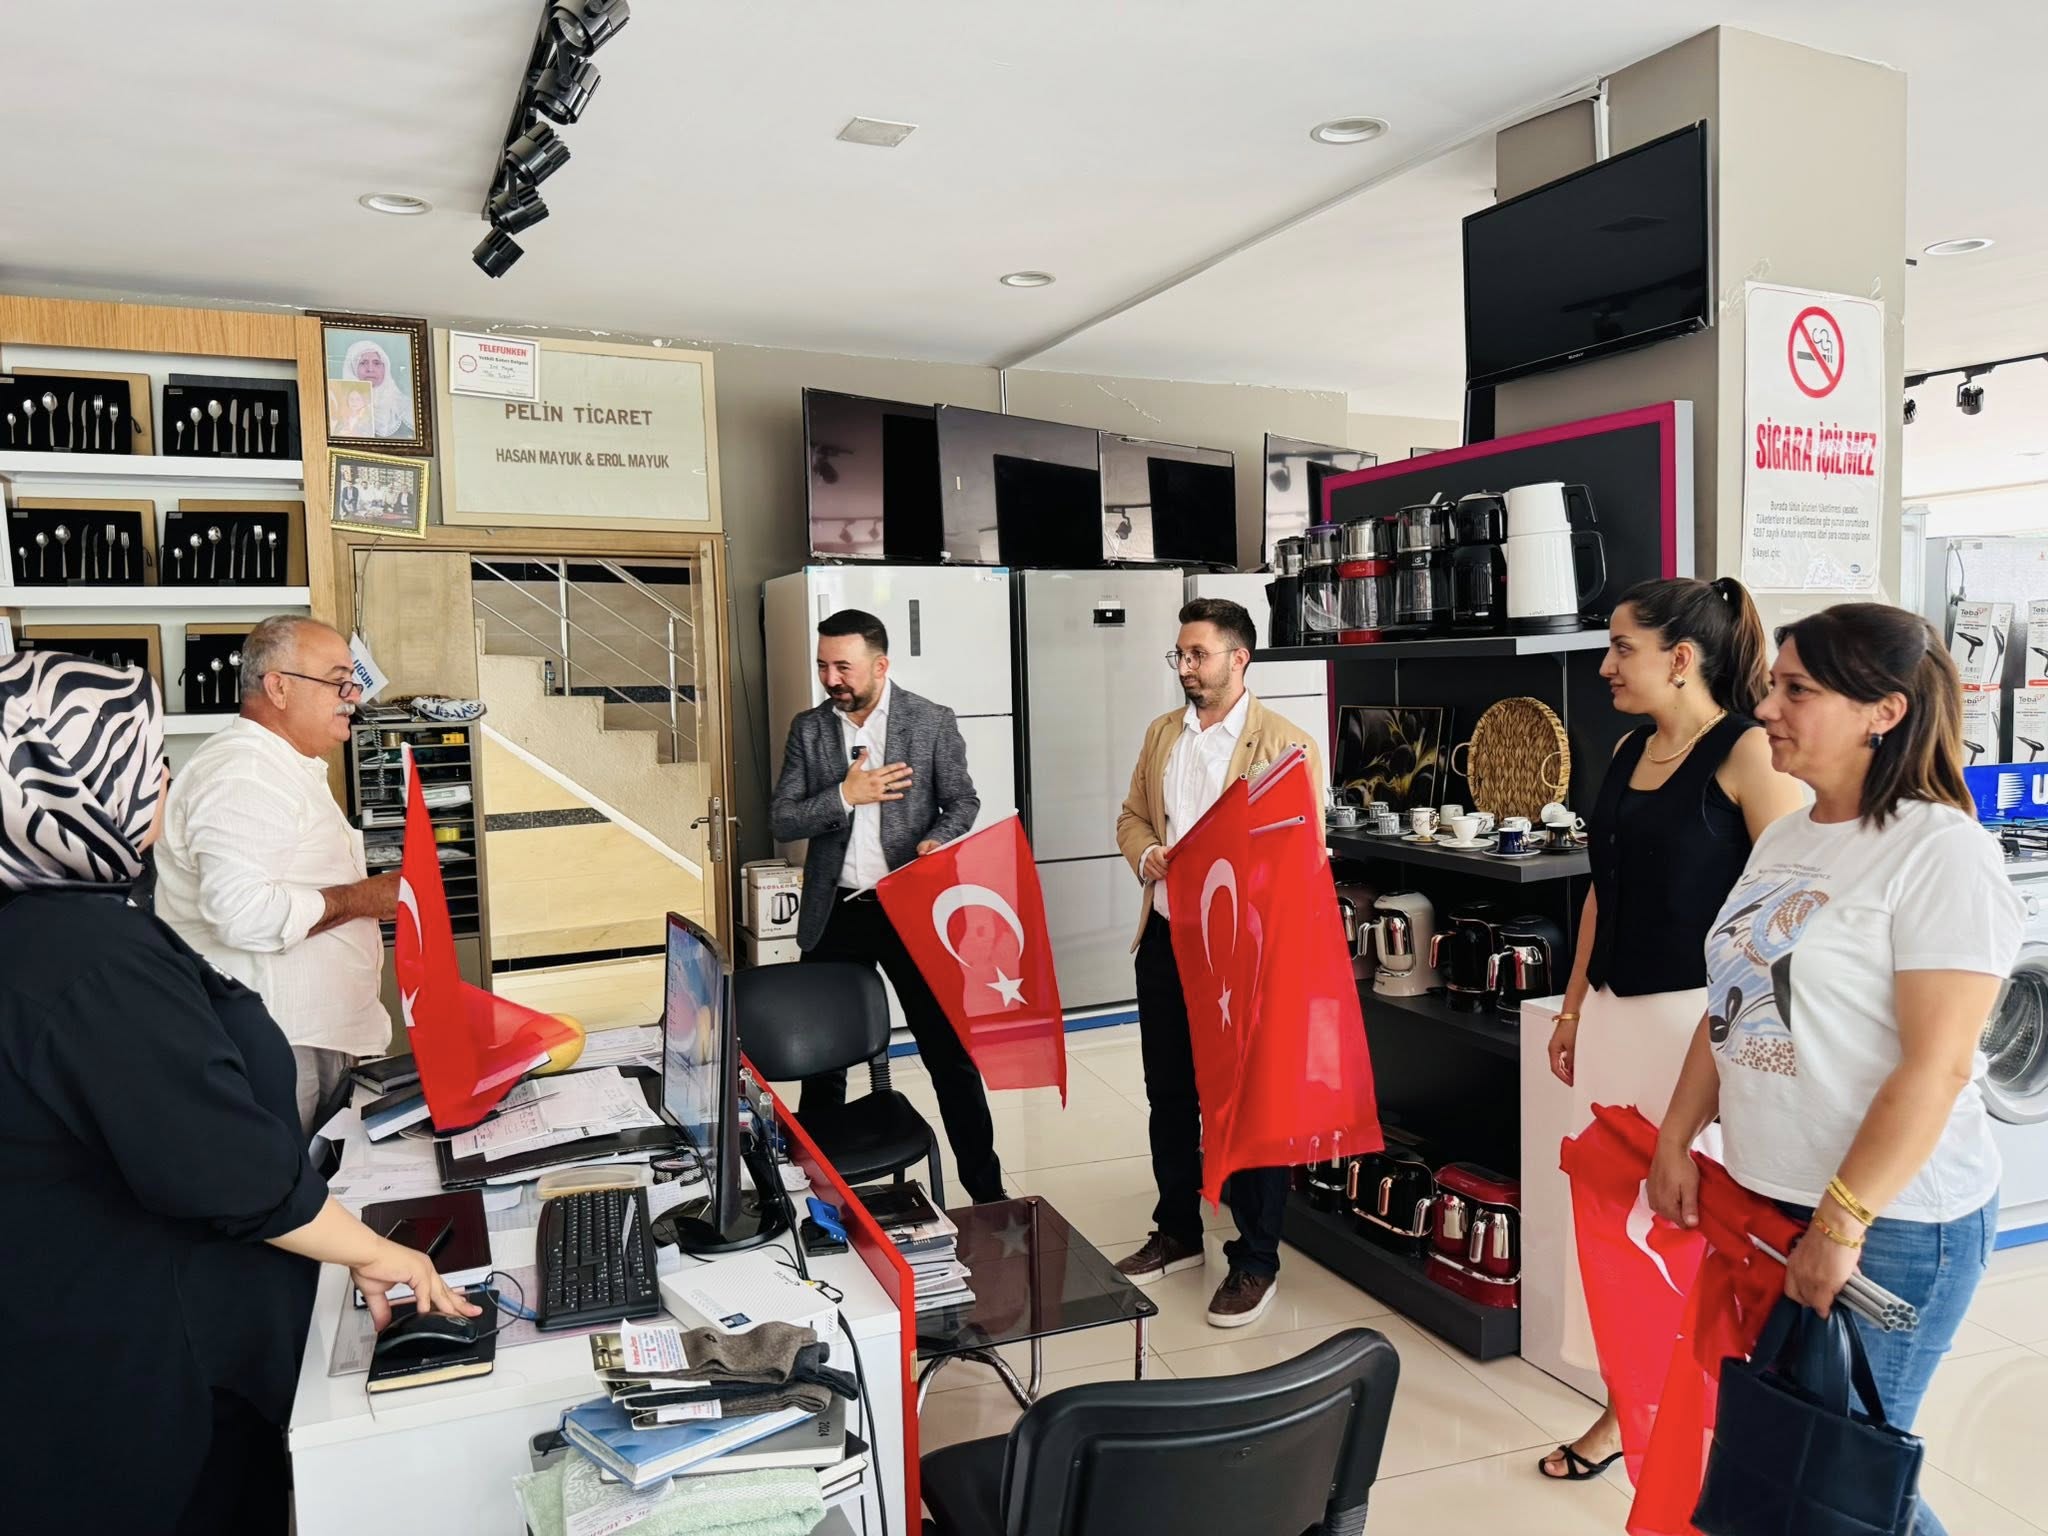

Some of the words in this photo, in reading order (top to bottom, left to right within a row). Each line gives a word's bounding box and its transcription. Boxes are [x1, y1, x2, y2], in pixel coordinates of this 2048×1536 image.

[478, 344, 527, 356] TELEFUNKEN
[505, 401, 563, 422] PELİN
[573, 403, 652, 426] TİCARET
[496, 448, 536, 464] HASAN
[539, 450, 582, 466] MAYUK
[585, 452, 595, 466] &
[598, 453, 626, 468] EROL
[628, 454, 669, 469] MAYUK
[1756, 417, 1813, 472] SİGARA
[1816, 421, 1877, 480] İÇİLMEZ
[818, 1421, 830, 1437] 2024
